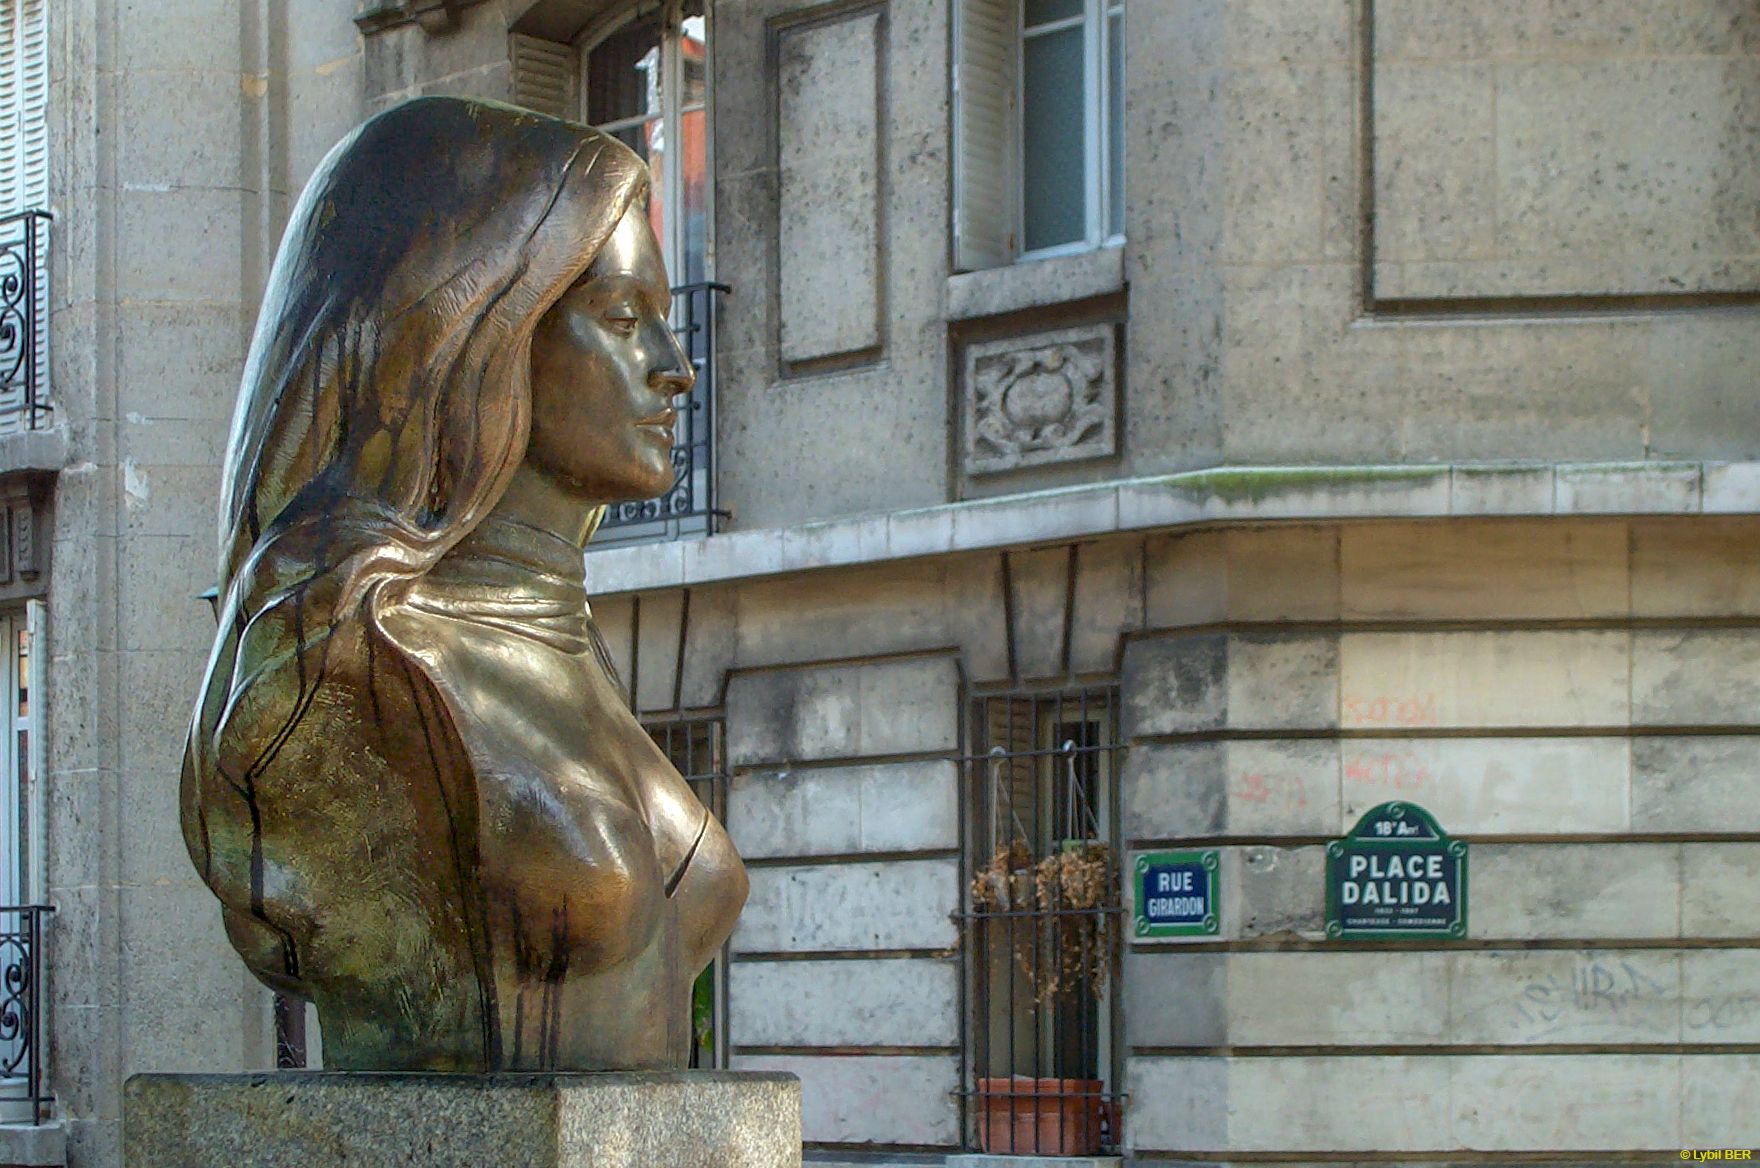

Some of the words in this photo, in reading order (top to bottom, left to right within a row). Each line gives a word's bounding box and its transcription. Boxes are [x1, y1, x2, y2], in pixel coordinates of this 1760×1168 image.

[1350, 854, 1444, 879] PLACE
[1157, 871, 1194, 892] RUE
[1341, 880, 1451, 905] DALIDA
[1147, 896, 1205, 918] GIRARDON
